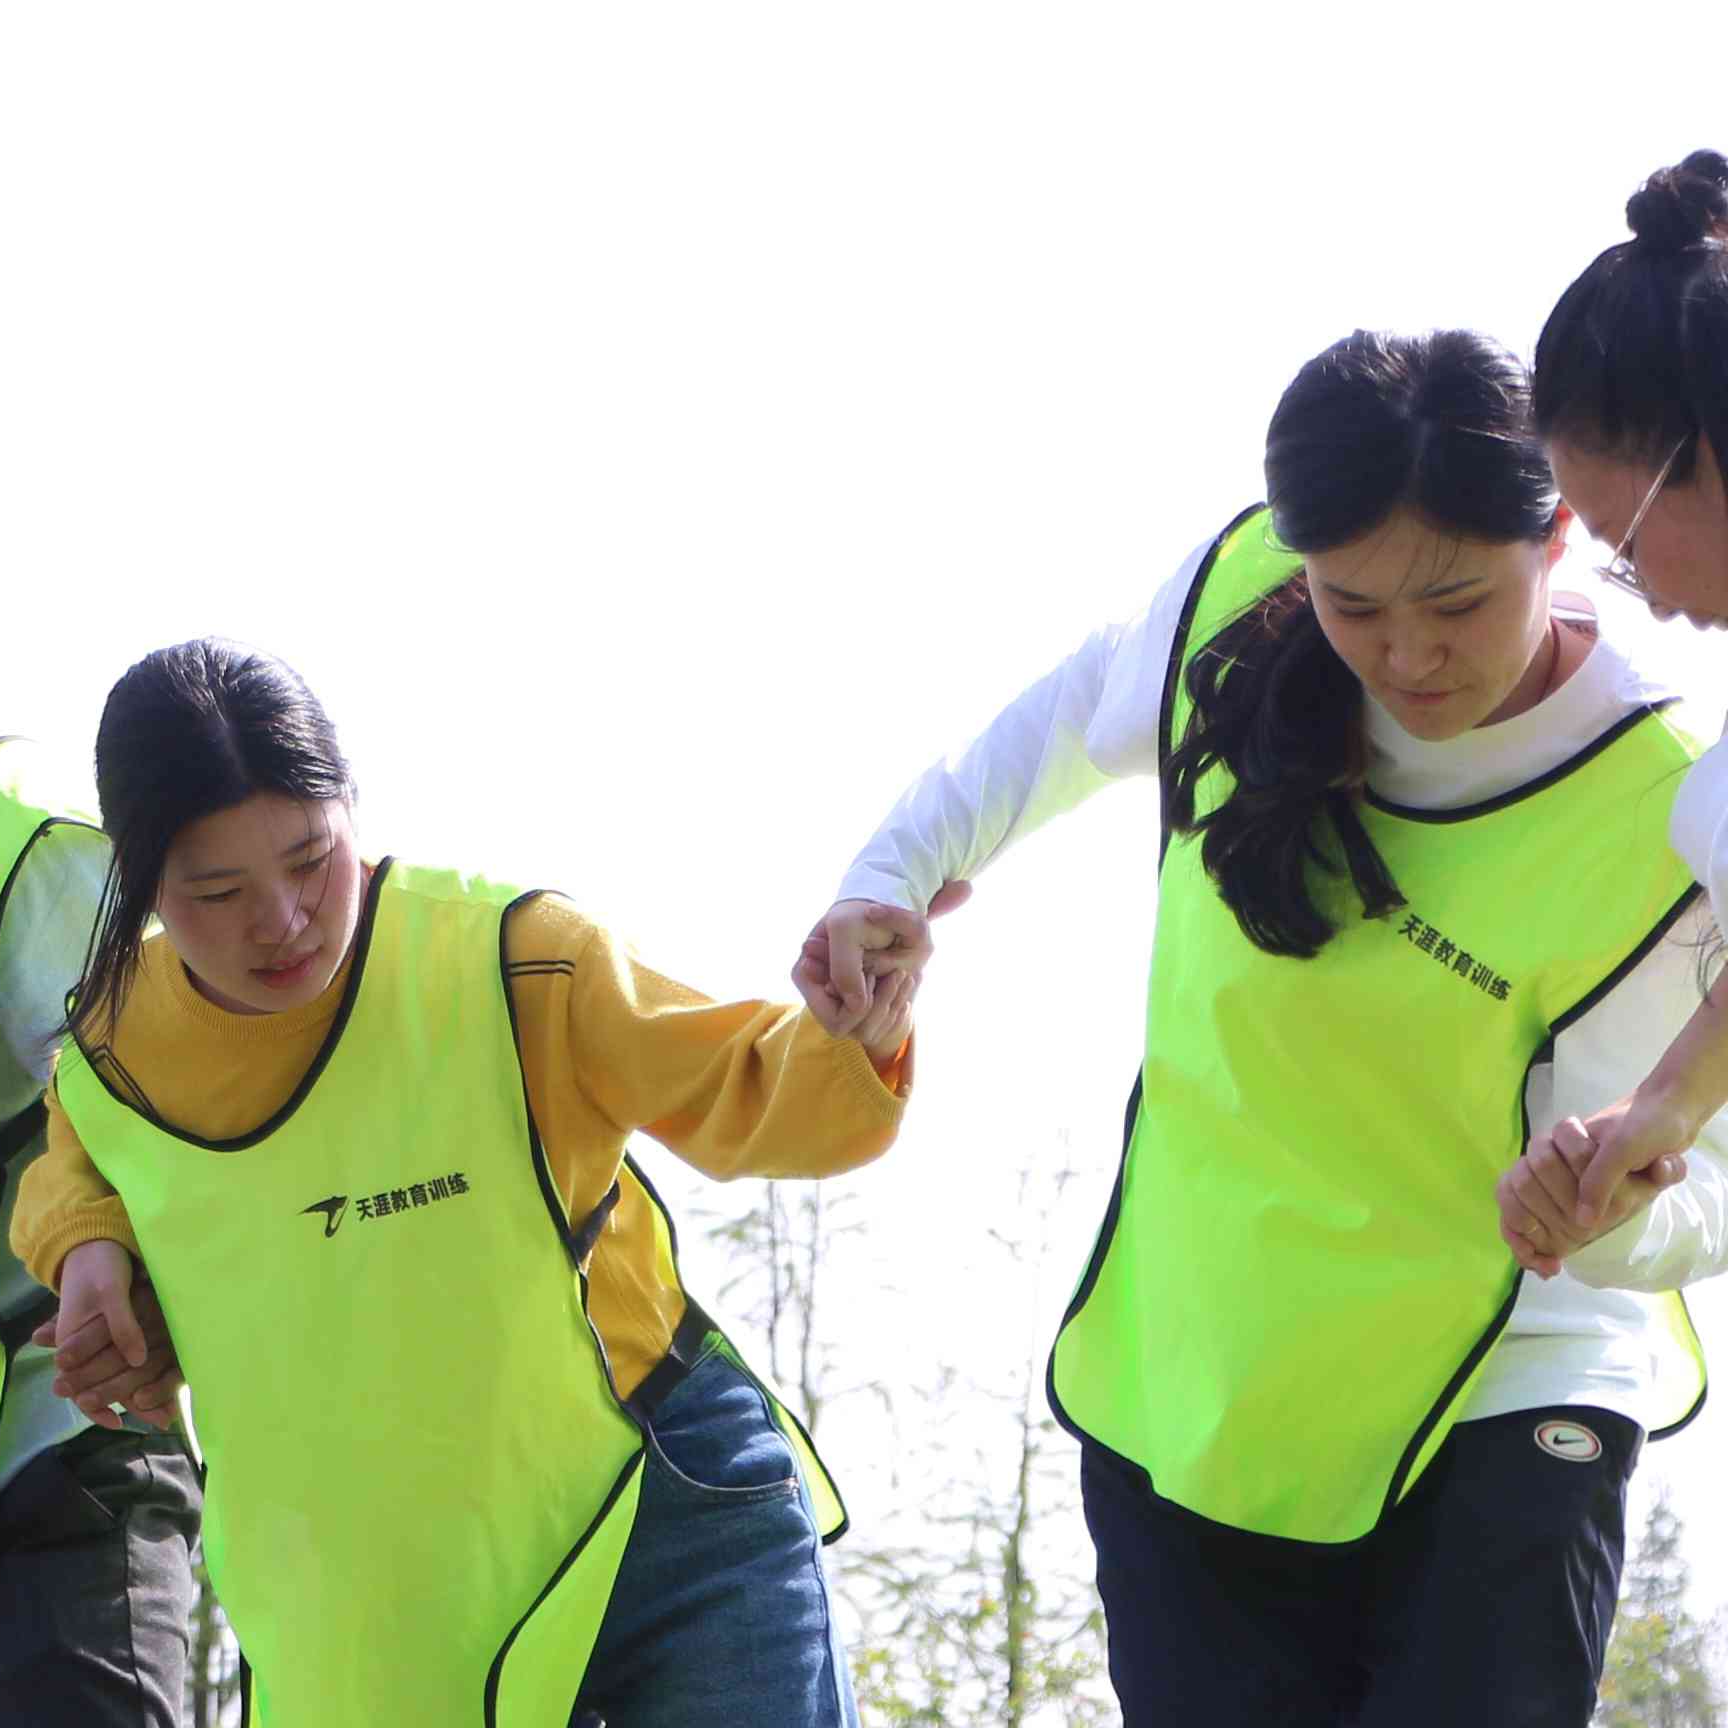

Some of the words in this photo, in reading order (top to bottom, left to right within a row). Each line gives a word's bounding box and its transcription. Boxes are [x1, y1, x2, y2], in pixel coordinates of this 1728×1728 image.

[1398, 912, 1512, 1001] 天涯教育训练
[355, 1172, 470, 1222] 天涯教育训练
